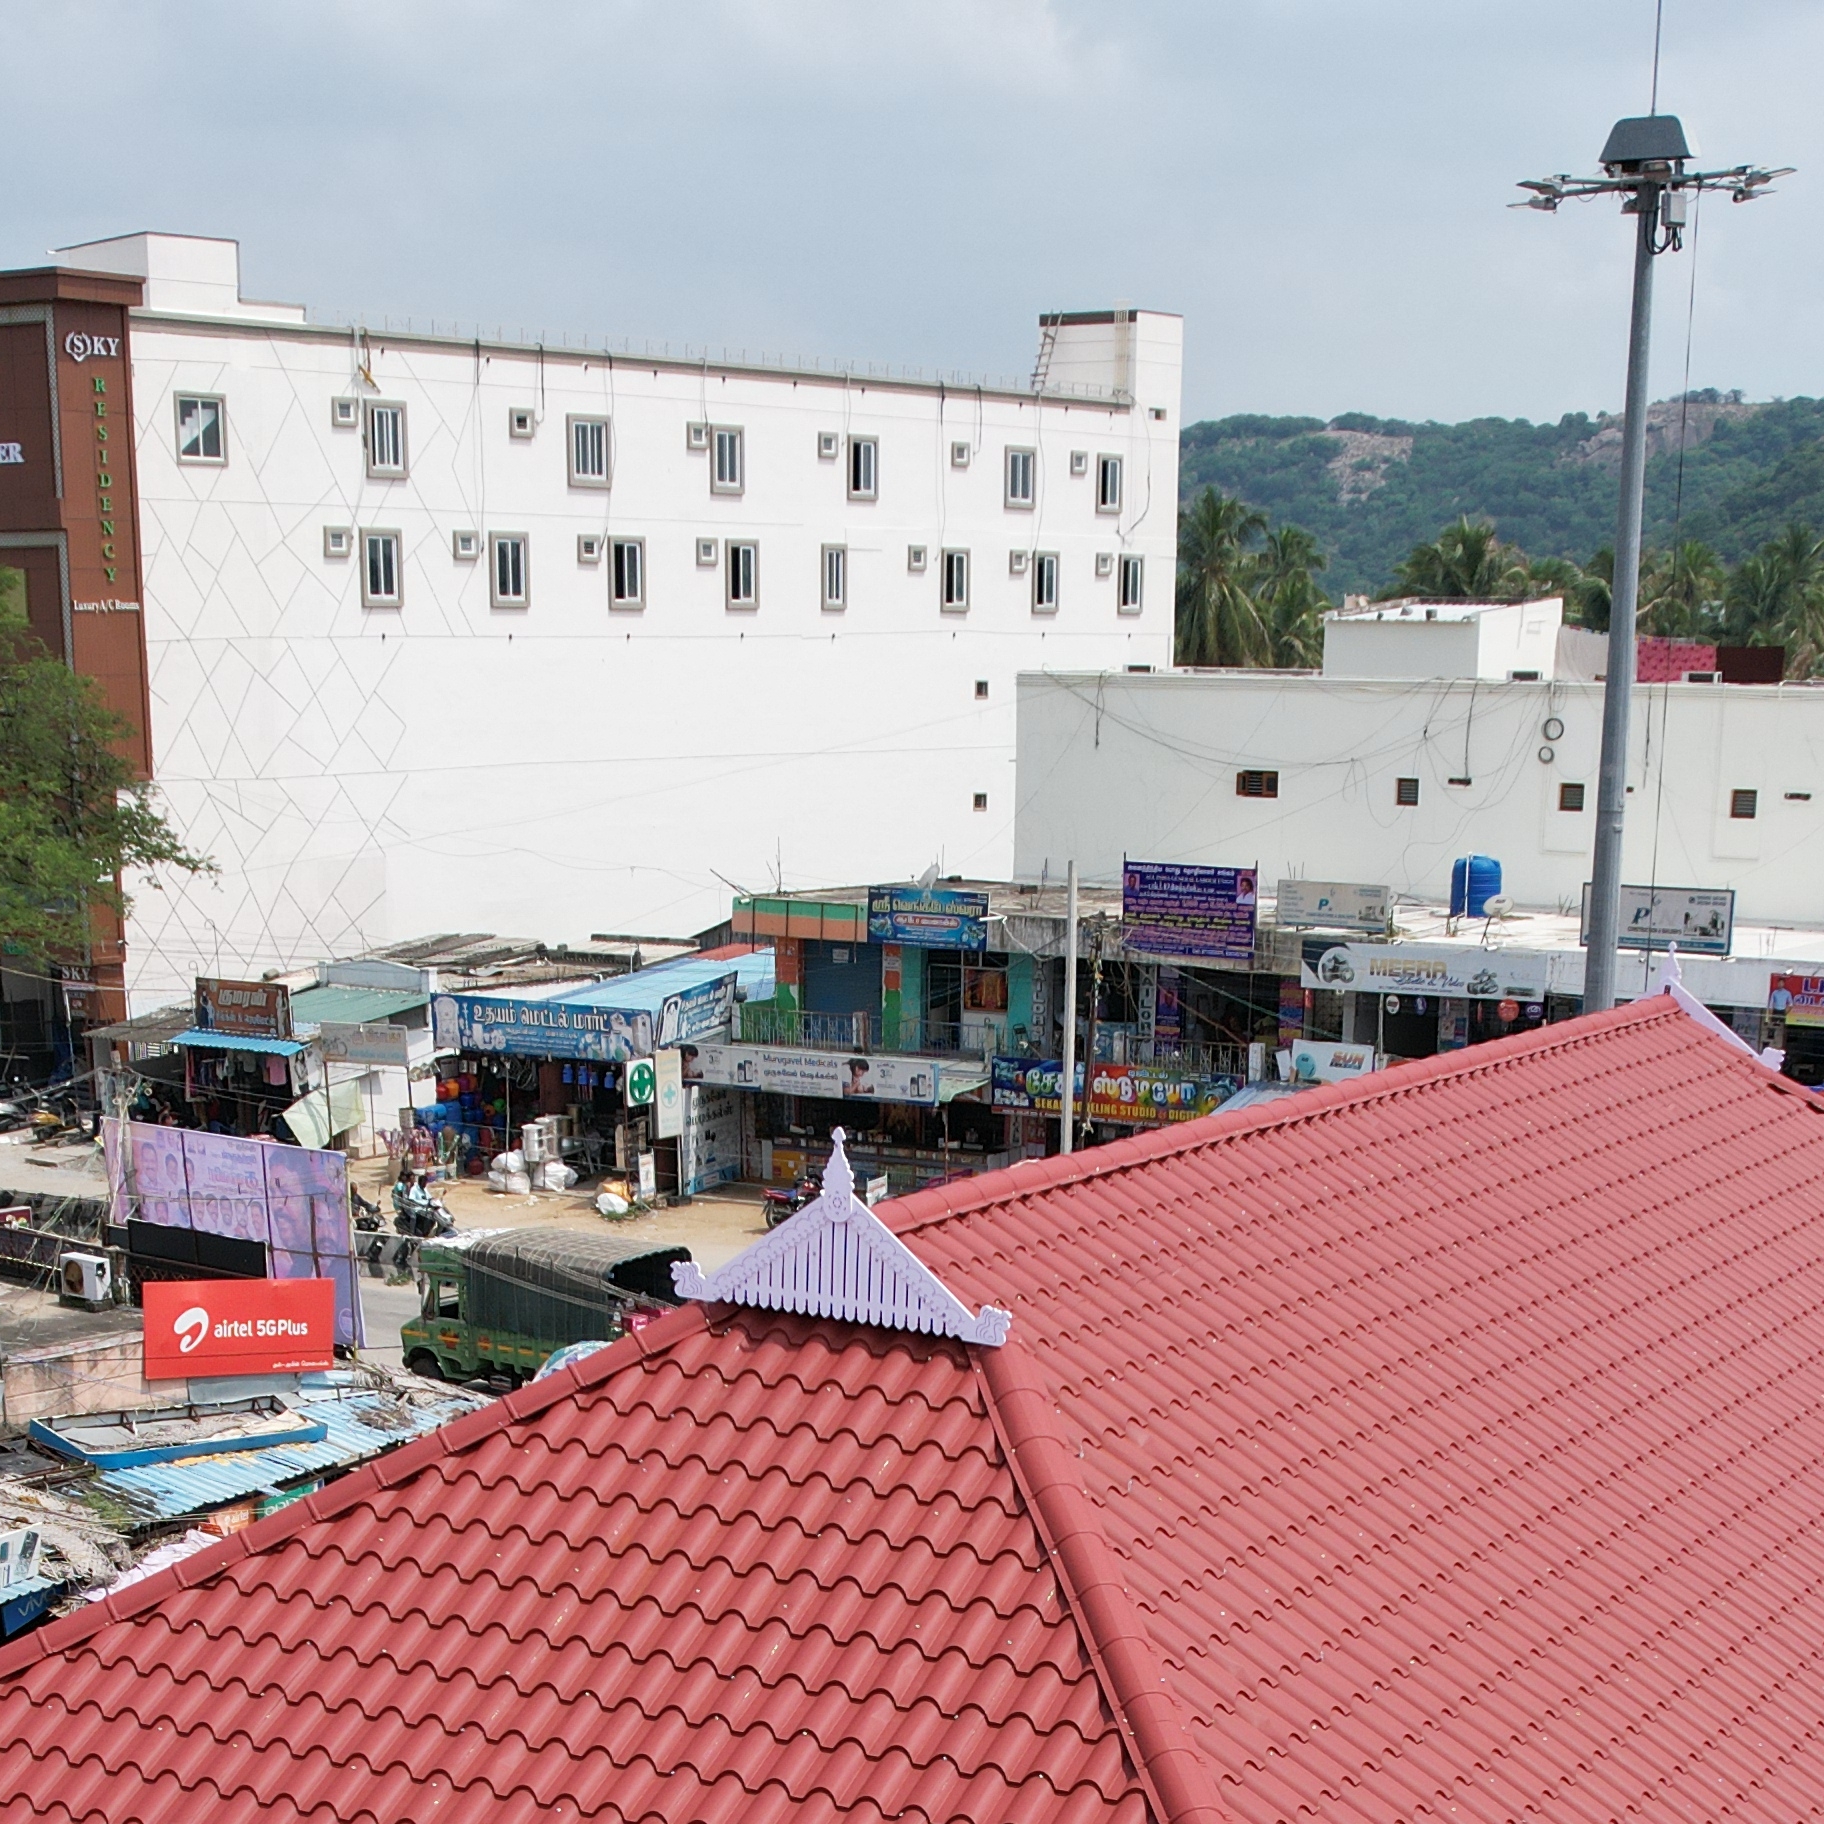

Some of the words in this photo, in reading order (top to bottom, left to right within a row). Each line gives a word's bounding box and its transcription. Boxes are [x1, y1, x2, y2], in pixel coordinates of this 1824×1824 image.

[93, 377, 117, 583] RESIDENCY
[61, 965, 91, 981] SKY
[1369, 957, 1447, 979] MEERA
[217, 988, 268, 1009] குமரன்
[472, 1001, 517, 1025] உதயம்
[521, 1006, 568, 1029] மெட்டல்
[573, 1008, 610, 1033] மார்ட்
[1034, 1097, 1063, 1111] SEKA
[1119, 1105, 1157, 1119] STUDIO
[213, 1319, 254, 1339] airtel
